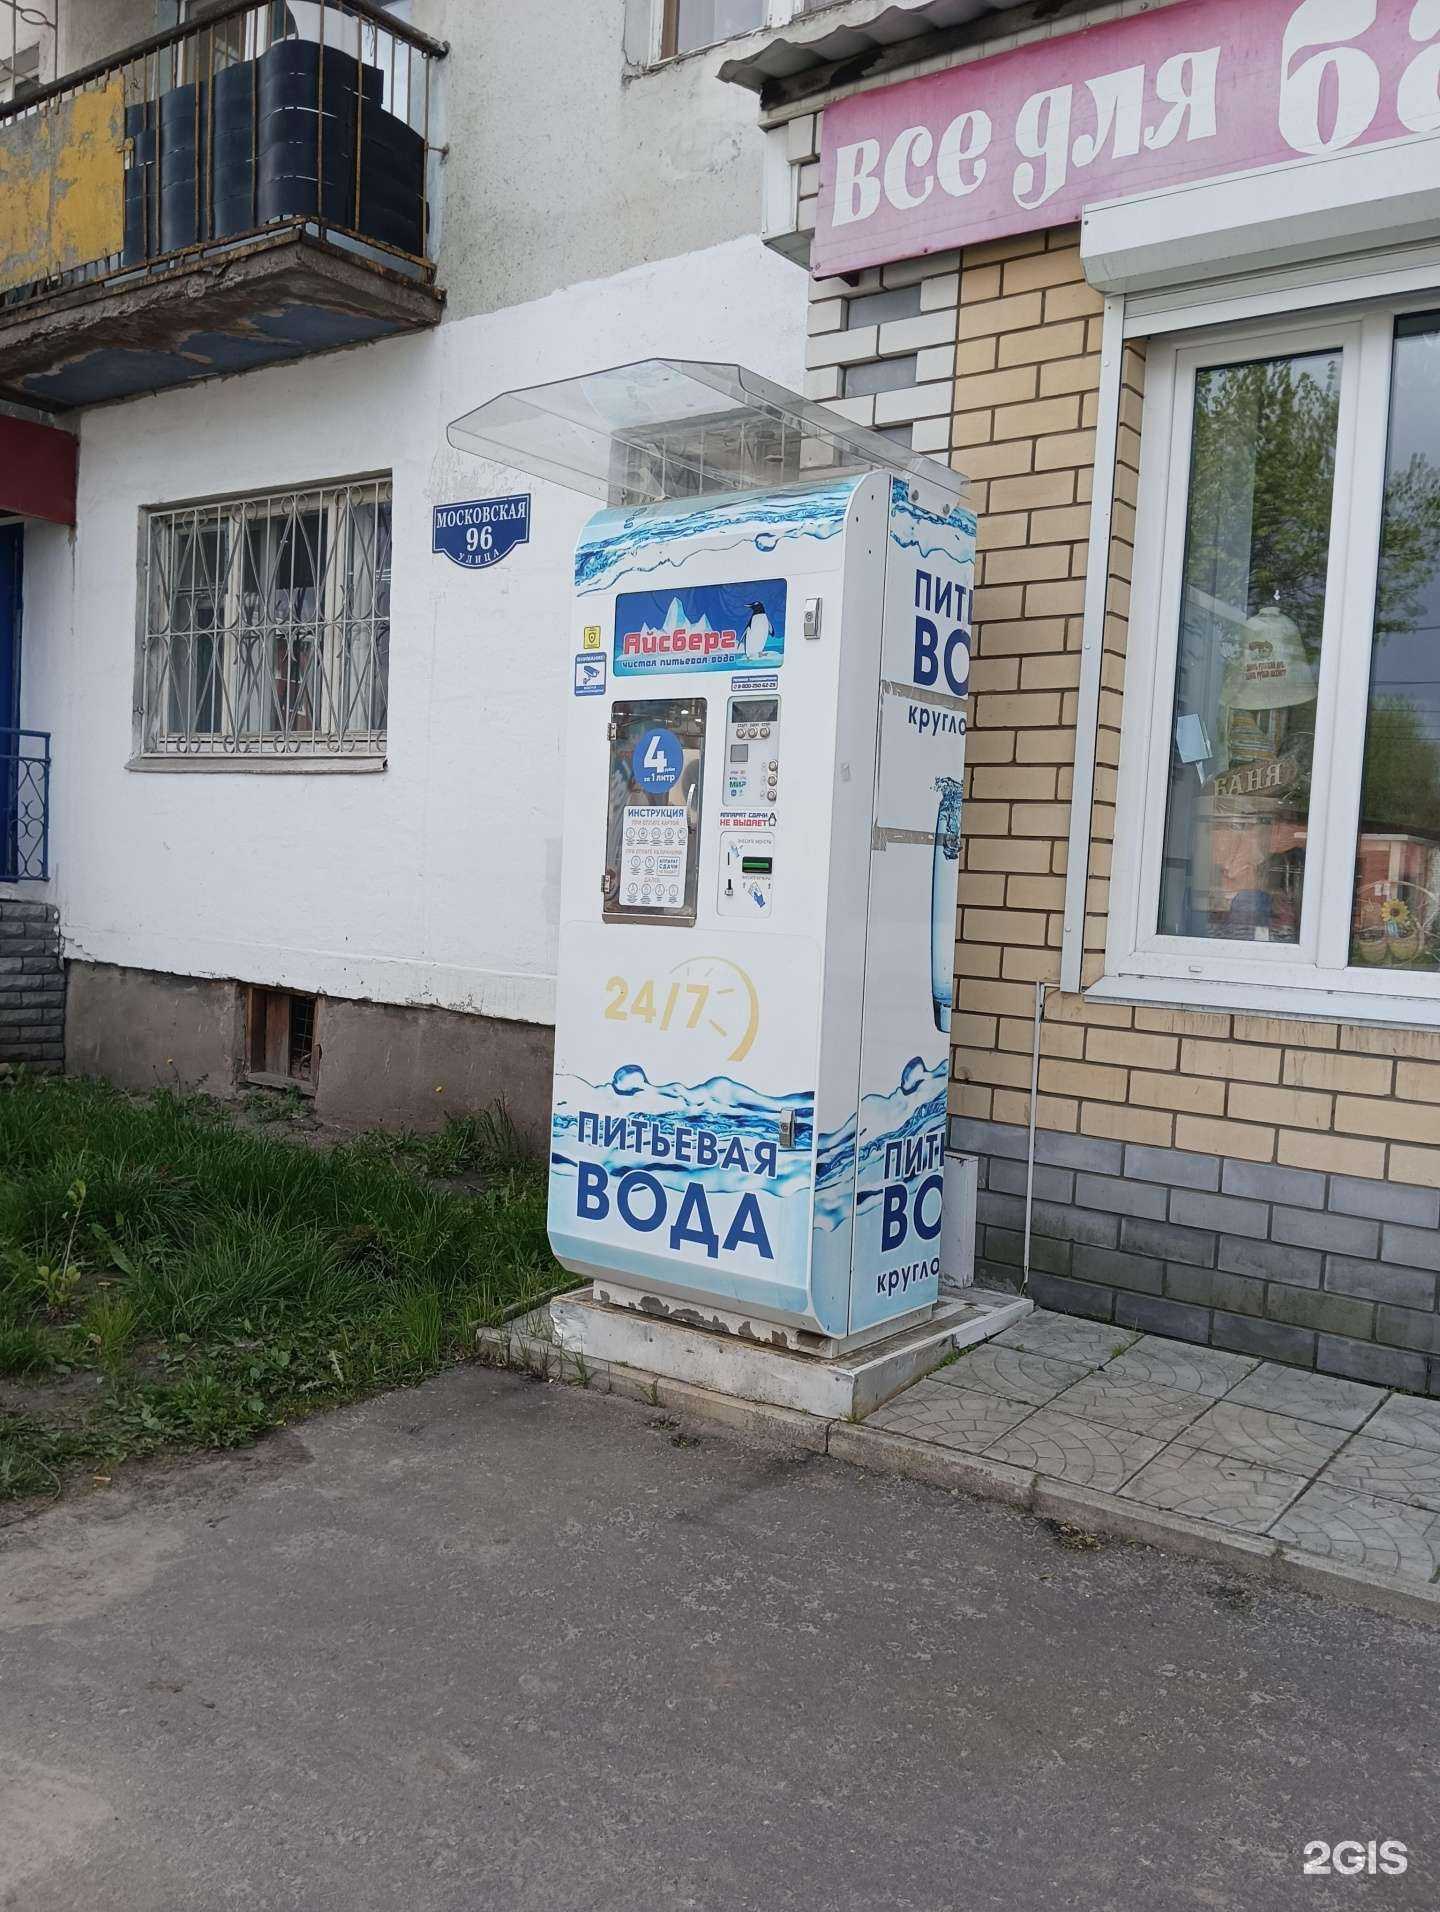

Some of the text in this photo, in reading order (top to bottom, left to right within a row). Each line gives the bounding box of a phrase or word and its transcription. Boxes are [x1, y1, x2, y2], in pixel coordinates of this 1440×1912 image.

[831, 109, 993, 227] все
[1012, 46, 1221, 210] для
[436, 501, 527, 528] МОСКОВСКАЯ
[466, 525, 493, 551] 96
[458, 549, 500, 564] УЛИЦА
[623, 629, 736, 655] Айсберг
[623, 654, 735, 668] чистая питьевая вода
[908, 704, 966, 736] кругло
[643, 735, 667, 773] 4
[628, 808, 684, 819] ИНСТРУКЦИЯ
[604, 975, 710, 1031] 24/7
[578, 1110, 777, 1178] ПИТЬЕВАЯ
[576, 1160, 774, 1260] ВОДА
[877, 1257, 940, 1297] кругло
